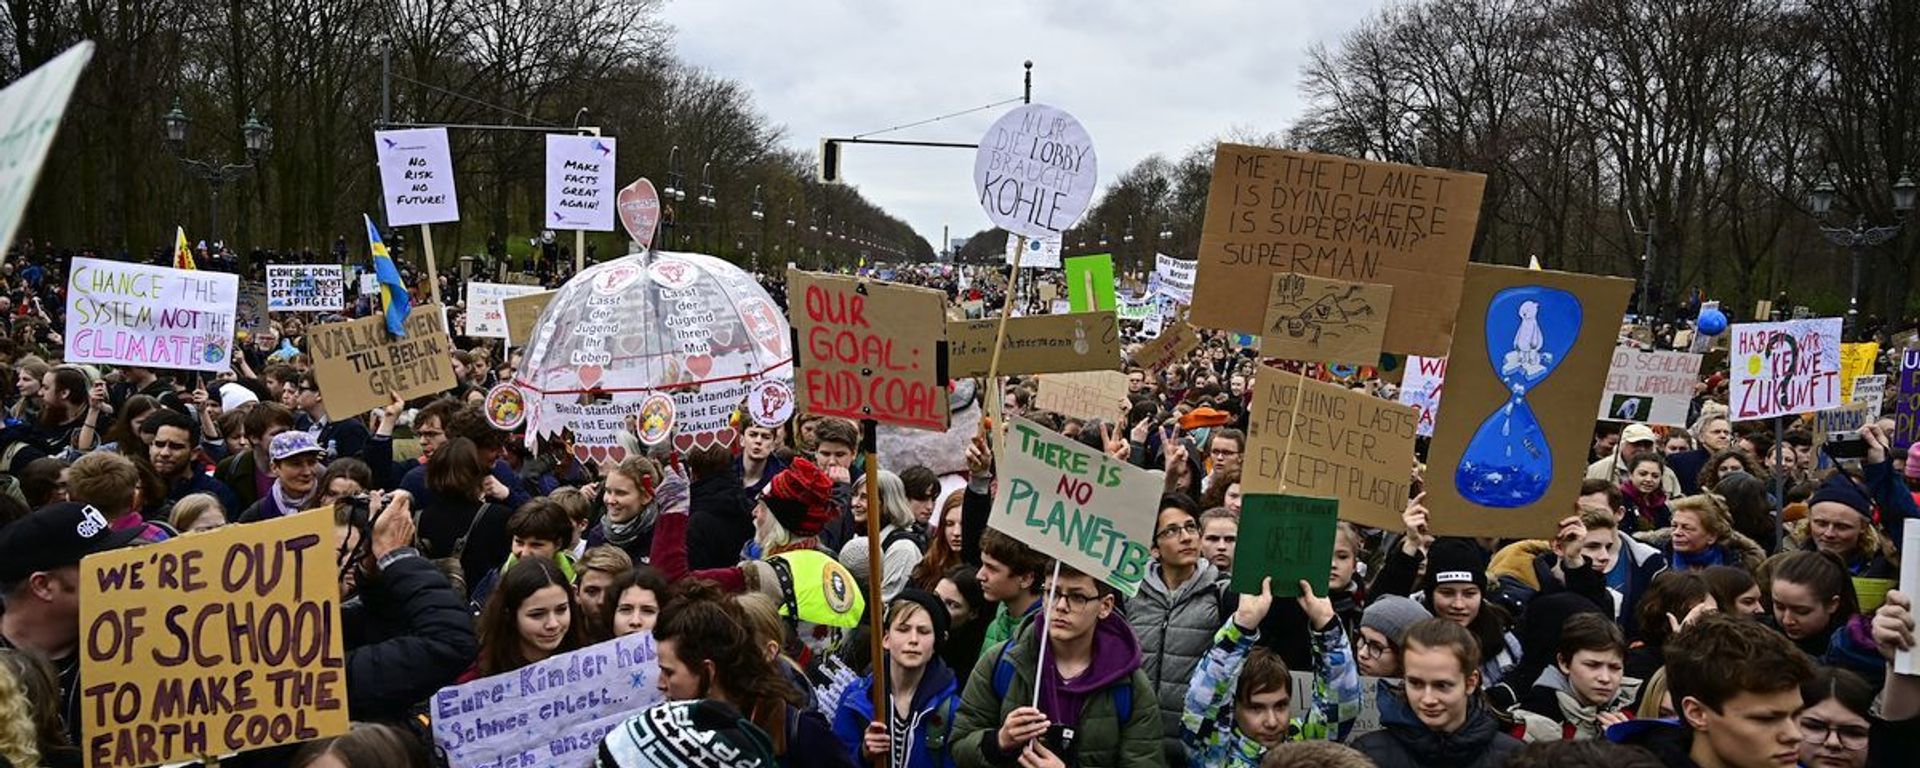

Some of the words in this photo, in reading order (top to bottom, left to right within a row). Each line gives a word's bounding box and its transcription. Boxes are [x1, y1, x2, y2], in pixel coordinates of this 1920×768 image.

[1021, 112, 1067, 141] NUR
[995, 127, 1025, 156] DIE
[1029, 137, 1091, 173] LOBBY
[408, 157, 427, 167] NO
[563, 160, 600, 172] MAKE
[988, 150, 1079, 194] BRAUCHT
[404, 170, 433, 180] RISK
[564, 174, 599, 185] FACTS
[1341, 163, 1449, 202] PLANET
[411, 183, 428, 192] NO
[561, 186, 600, 198] GREAT
[1233, 184, 1261, 208] IS
[396, 194, 446, 205] FUTURE!
[559, 198, 600, 211] AGAIN!
[981, 170, 1067, 232] KOHLE
[1228, 211, 1256, 234] IS
[269, 267, 308, 278] ERHEBE
[312, 267, 341, 278] DEINE
[271, 278, 313, 288] STIMME
[315, 279, 342, 288] NICHT
[72, 266, 164, 299] CHANGE
[178, 276, 218, 303] THE
[271, 288, 292, 298] DEN
[662, 288, 696, 299] Lasst
[285, 298, 342, 307] SPIEGEL!
[589, 295, 621, 305] Lasst
[678, 301, 699, 311] der
[805, 284, 871, 328] OUR
[74, 297, 157, 331] SYSTEM,
[160, 307, 201, 329] NOT
[203, 311, 232, 333] THE
[592, 309, 611, 319] der
[667, 312, 714, 327] Jugend
[575, 323, 619, 335] Jugend
[677, 328, 710, 339] Ihren
[72, 328, 202, 366] CLIMATE
[585, 337, 602, 347] Ihr
[684, 342, 709, 353] Mut
[809, 325, 918, 371] GOAL:
[952, 341, 966, 356] ist
[971, 342, 987, 354] ein
[1739, 329, 1787, 355] HABEN
[1796, 329, 1820, 353] WIR
[346, 350, 385, 373] TILL
[572, 352, 609, 363] Leben
[1635, 353, 1699, 374] SCHLAU
[1772, 351, 1822, 380] KEINE
[369, 356, 440, 396] GRETA!
[697, 384, 751, 403] standhaft
[805, 368, 862, 412] END
[869, 375, 945, 419] COAL
[1739, 371, 1838, 417] ZUKUNFT
[555, 403, 583, 415] Bleibt
[585, 402, 640, 416] standhaft
[691, 407, 706, 418] ist
[710, 403, 737, 416] Eure
[1269, 383, 1346, 420] NOTHING
[1358, 402, 1415, 440] LASTS
[568, 420, 580, 429] es
[582, 420, 595, 430] ist
[597, 420, 625, 430] Eure
[681, 419, 729, 433] Zukunft
[576, 433, 618, 444] Zukunft
[1015, 424, 1091, 463] THERE
[1056, 473, 1093, 506] NO
[1259, 446, 1346, 494] EXCEPT
[1348, 467, 1409, 513] PLASTIC
[1006, 477, 1126, 567] PLANET
[1111, 540, 1153, 583] B
[97, 549, 208, 593] WE'RE
[221, 534, 320, 603] OUT
[87, 607, 147, 666] OF
[152, 600, 344, 668] SCHOOL
[85, 681, 141, 727] TO
[152, 670, 257, 722] MAKE
[265, 668, 342, 711] THE
[437, 682, 504, 720] Eure
[519, 655, 608, 698] Kinder
[91, 720, 208, 768] EARTH
[224, 708, 319, 750] COOL
[443, 710, 529, 751] Schnee
